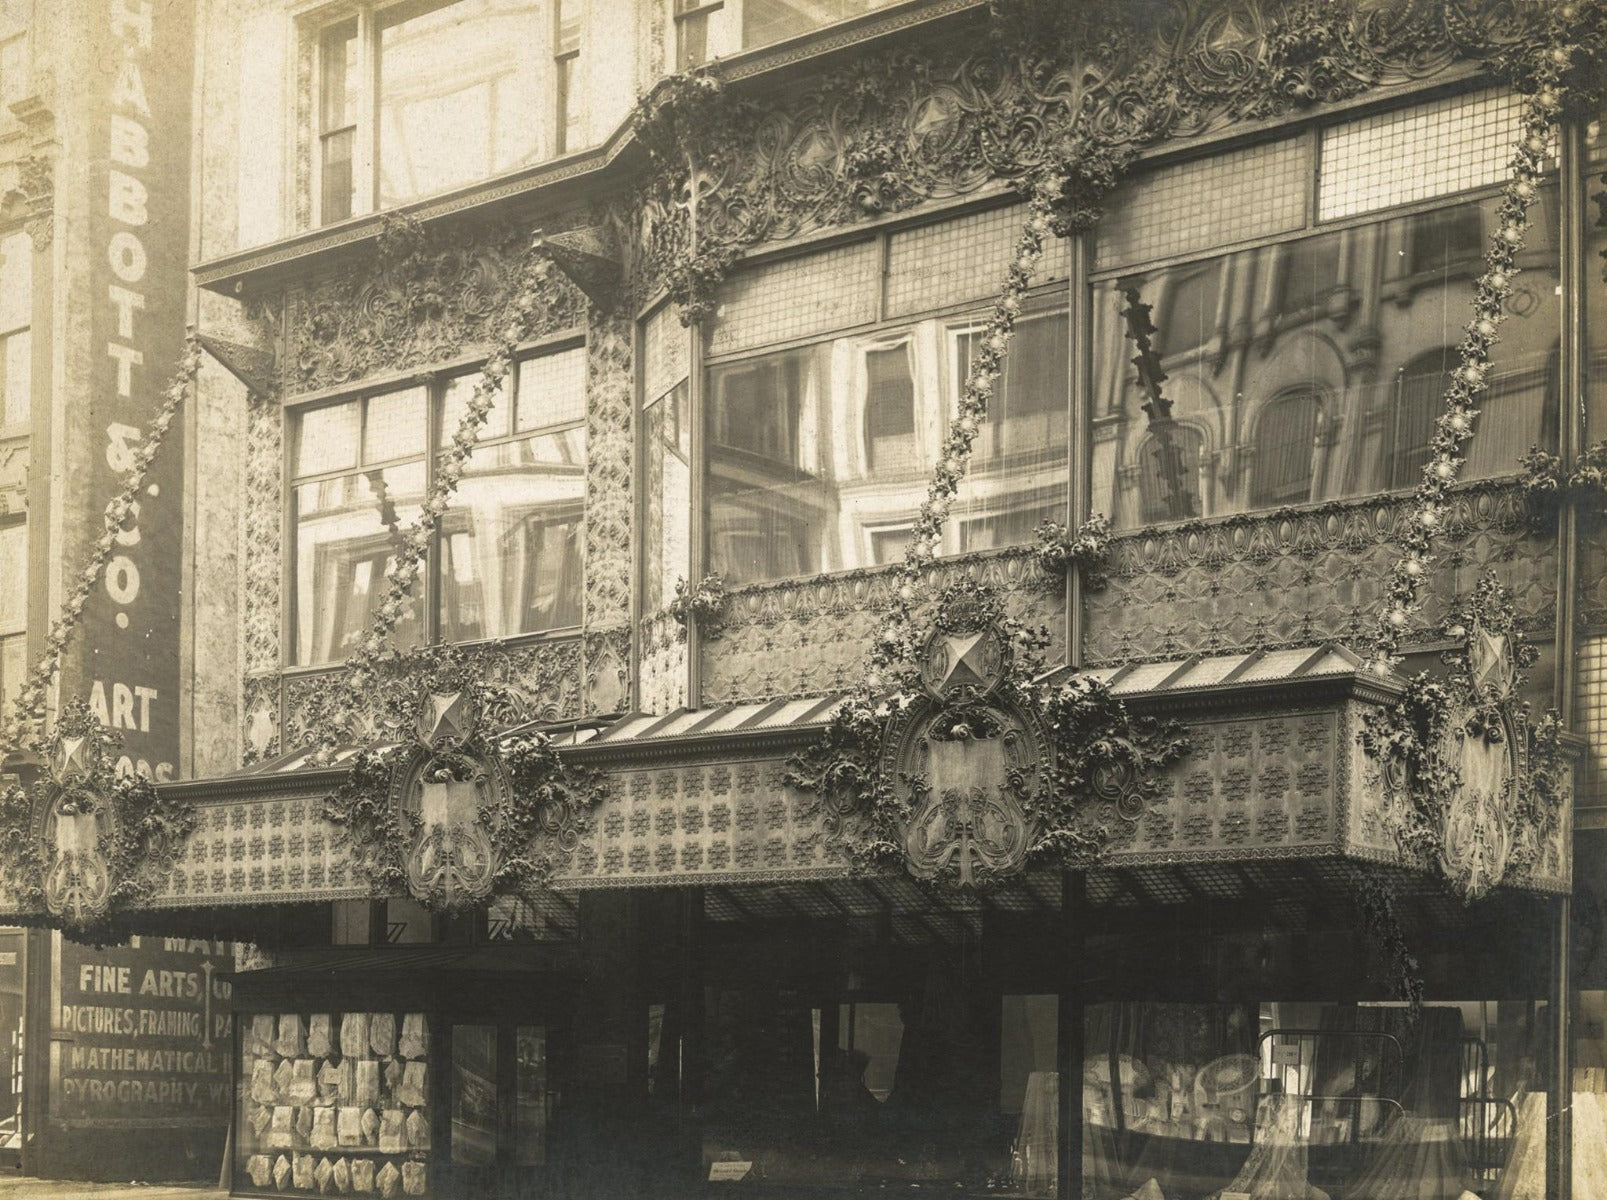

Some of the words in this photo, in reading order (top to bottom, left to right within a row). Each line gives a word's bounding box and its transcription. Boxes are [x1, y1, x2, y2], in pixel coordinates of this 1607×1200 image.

[107, 62, 152, 398] ABBOTT
[106, 422, 142, 473] &
[89, 680, 158, 733] ART
[80, 965, 131, 994] FINE
[71, 1047, 218, 1073] MATHEMATICAL
